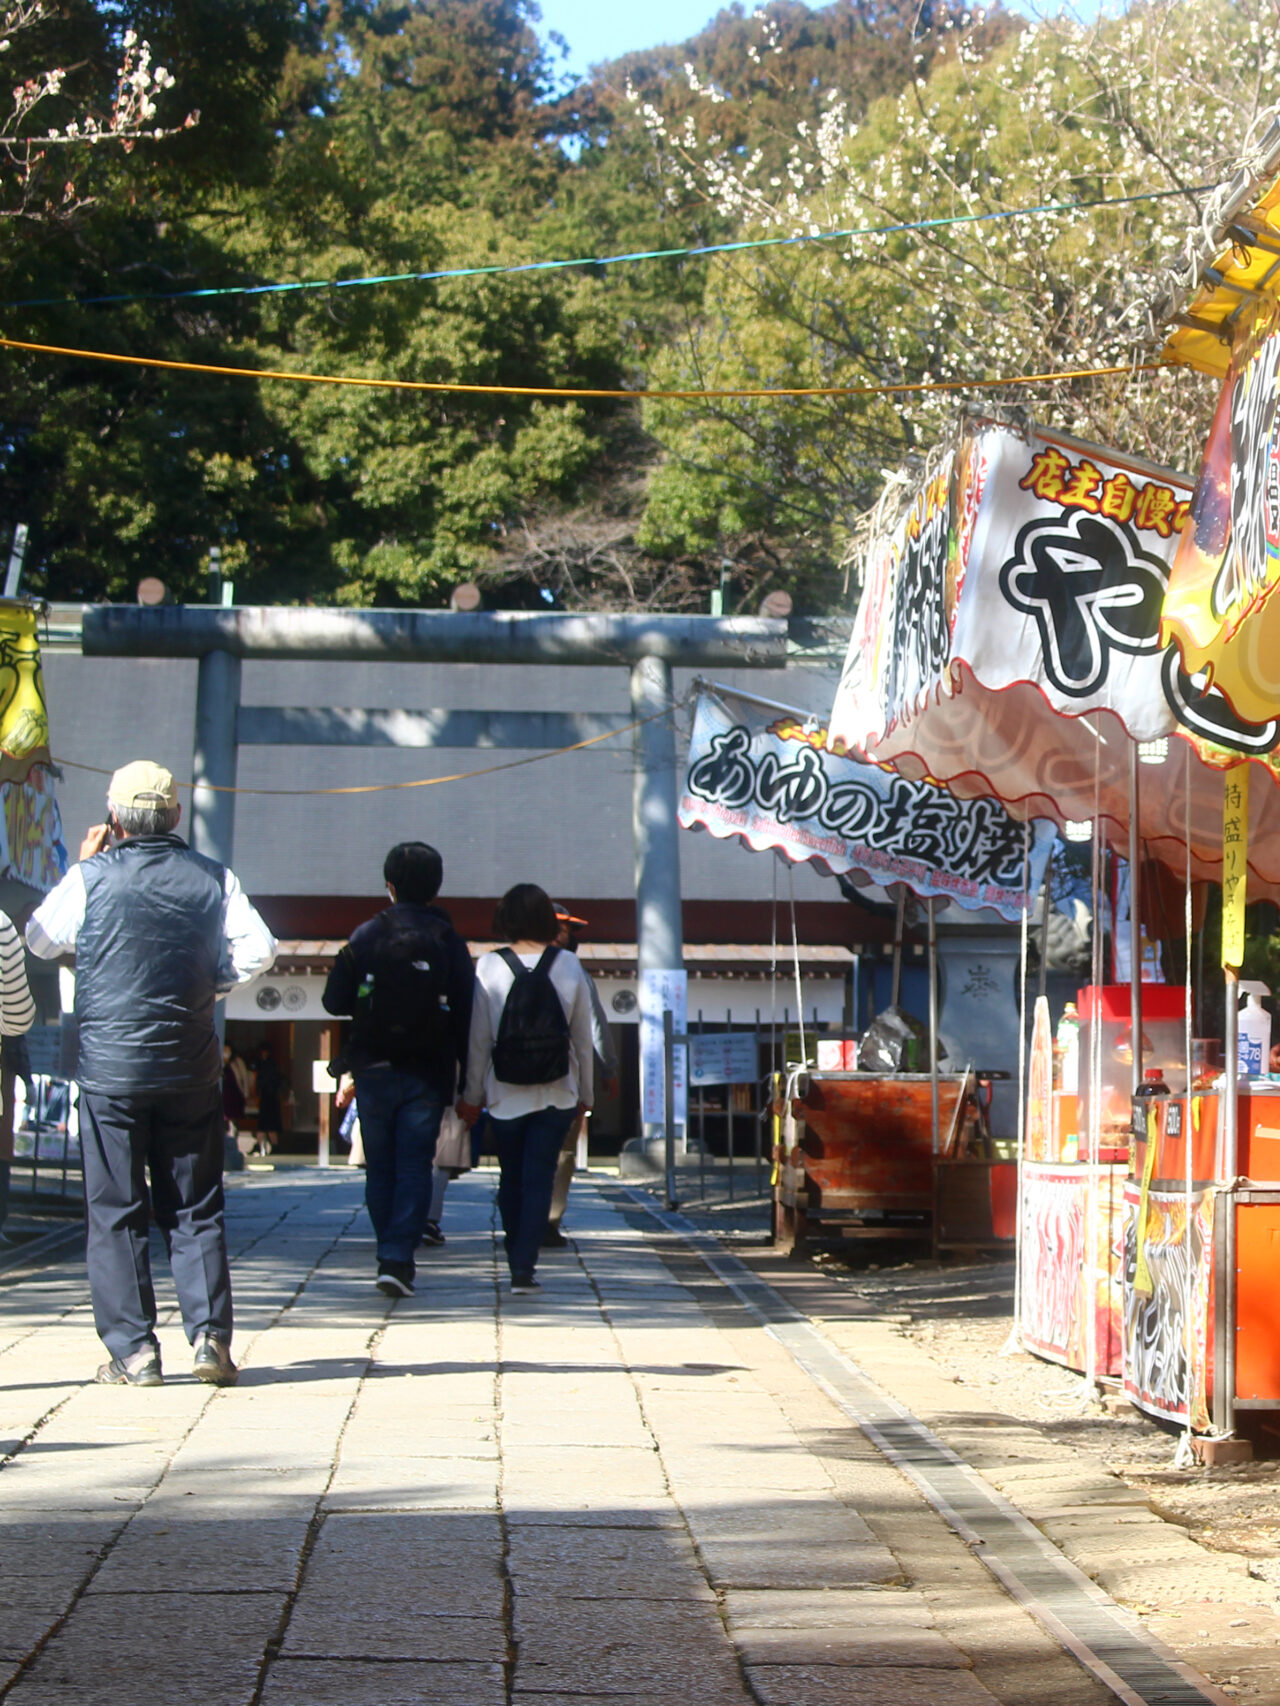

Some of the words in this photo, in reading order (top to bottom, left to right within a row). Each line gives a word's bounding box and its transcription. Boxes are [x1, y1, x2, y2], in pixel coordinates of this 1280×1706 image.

[688, 725, 1035, 890] あゆの塩焼
